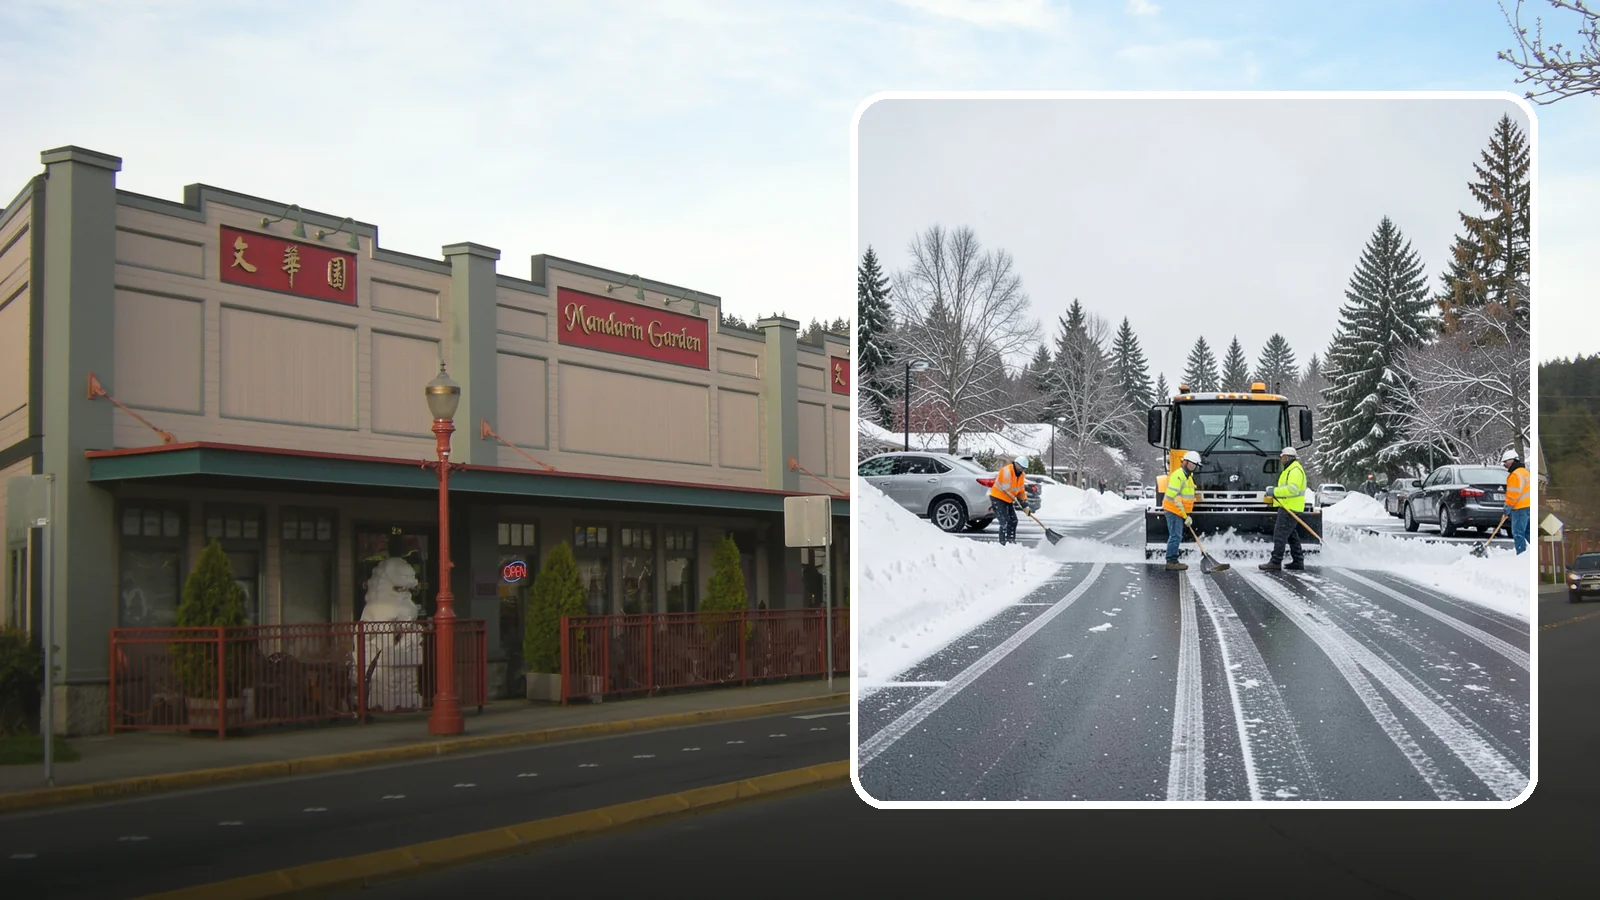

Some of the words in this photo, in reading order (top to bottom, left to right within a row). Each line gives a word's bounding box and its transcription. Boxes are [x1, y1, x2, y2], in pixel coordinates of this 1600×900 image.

[231, 236, 346, 290] 文華園
[564, 302, 644, 341] Mandarin
[648, 320, 701, 352] Garden
[834, 363, 846, 386] 文
[503, 565, 526, 578] OPEN
